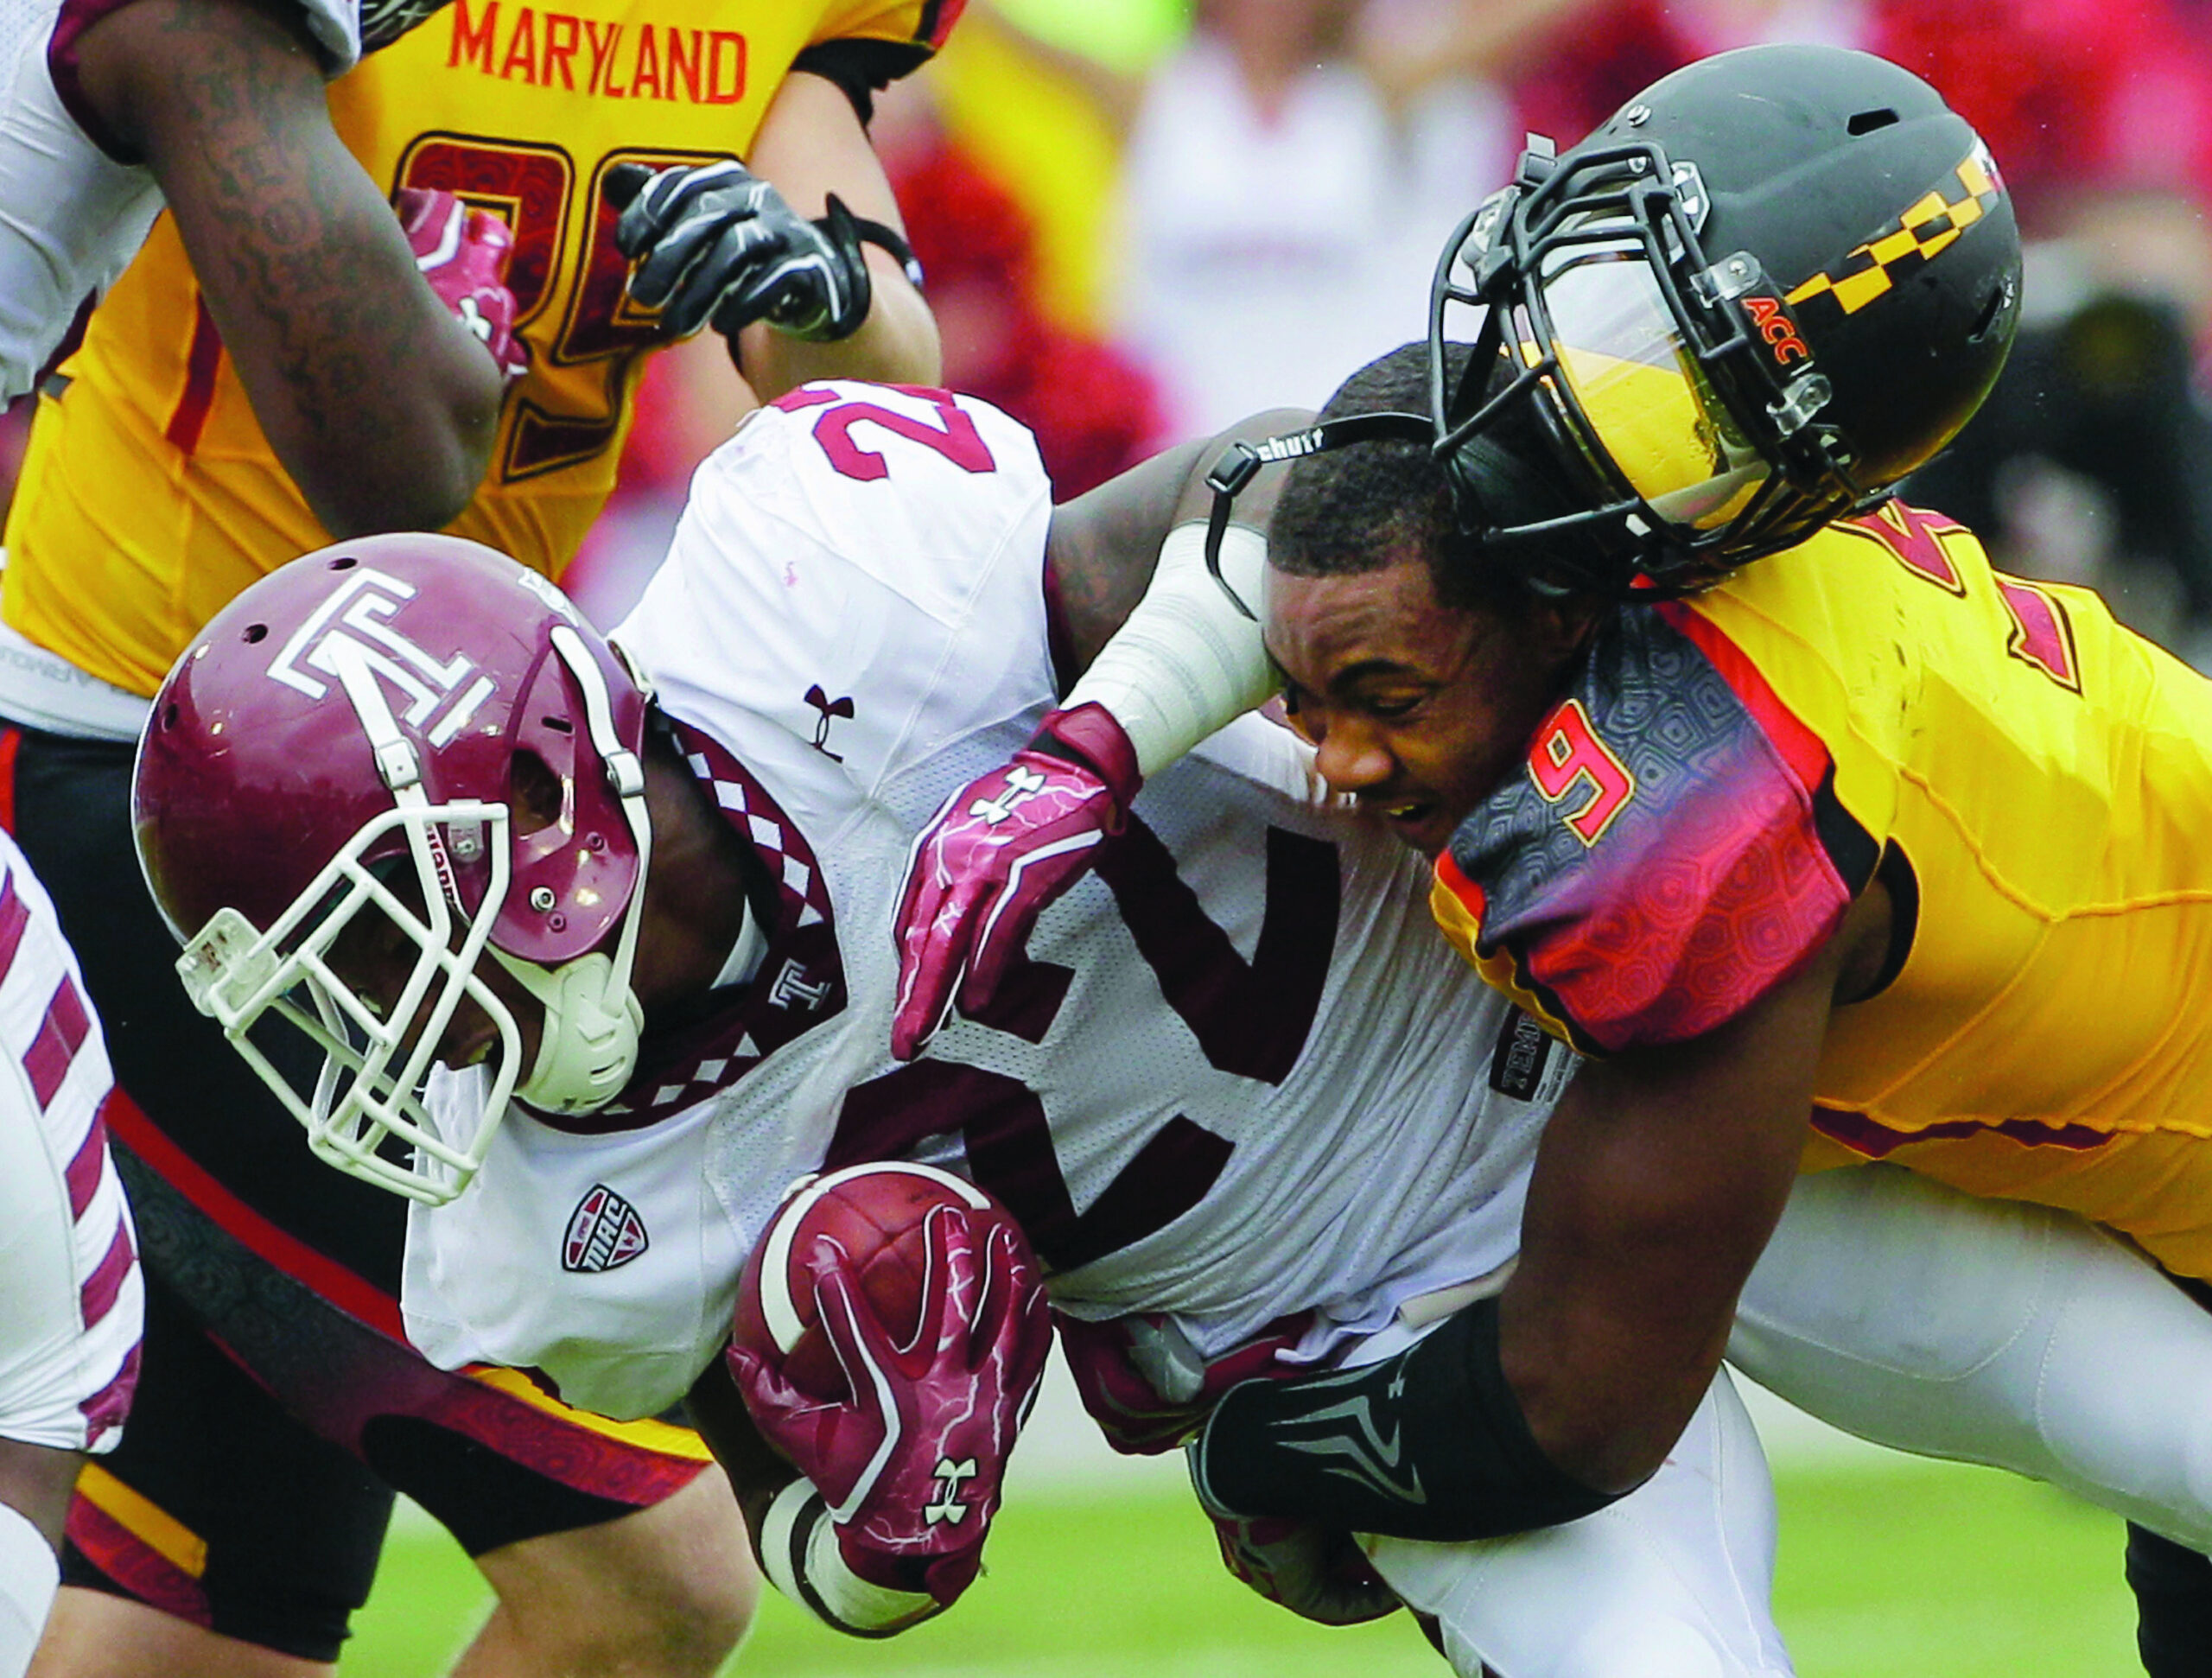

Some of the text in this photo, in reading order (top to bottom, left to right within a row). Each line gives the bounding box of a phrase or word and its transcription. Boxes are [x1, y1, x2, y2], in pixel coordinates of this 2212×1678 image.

[446, 0, 748, 105] MARYLAND
[1739, 297, 1808, 365] ACC
[1255, 427, 1325, 462] chutt
[1527, 699, 1637, 848] 9
[581, 1195, 628, 1272] MAC
